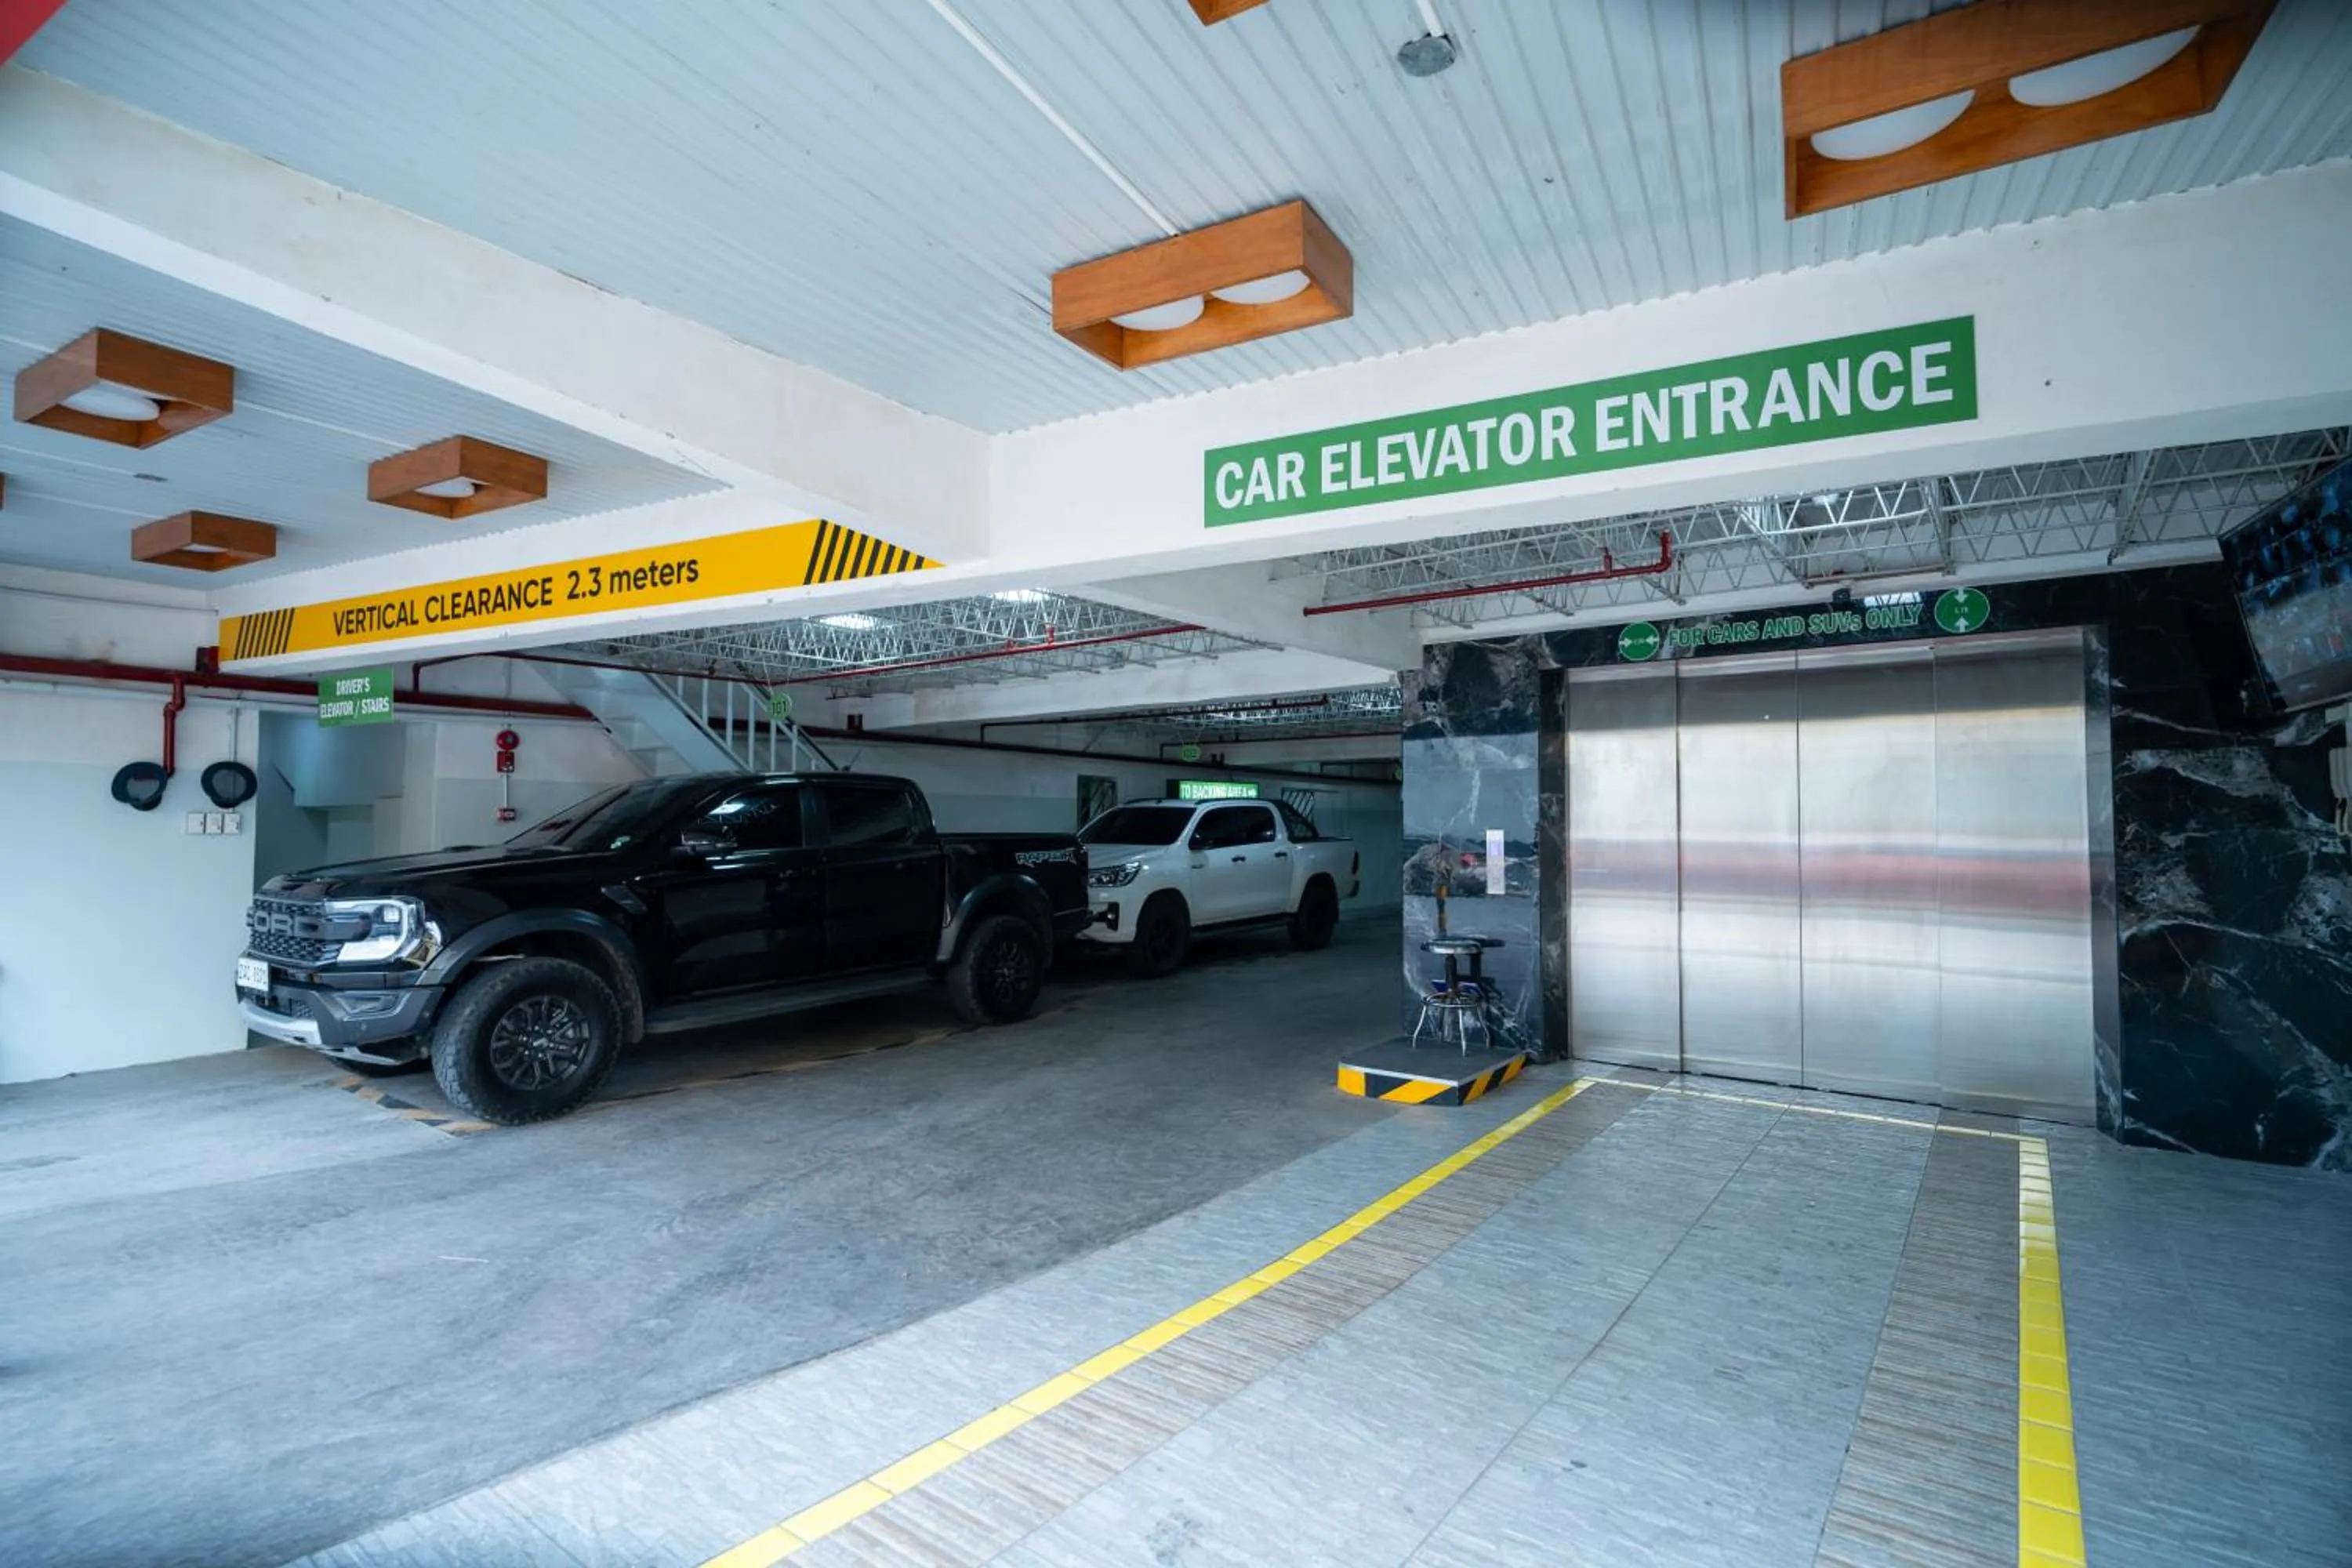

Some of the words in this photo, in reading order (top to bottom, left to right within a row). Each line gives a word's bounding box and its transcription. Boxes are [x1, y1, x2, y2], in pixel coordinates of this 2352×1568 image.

[1215, 451, 1306, 509] CAR
[1320, 406, 1577, 494] ELEVATOR
[1595, 342, 1952, 452] ENTRANCE
[333, 601, 419, 636] VERTICAL
[425, 577, 553, 623] CLEARANCE
[567, 567, 601, 600] 2.3
[610, 558, 699, 593] meters
[1668, 629, 1705, 647] FOR
[1707, 621, 1760, 644] CARS
[1762, 615, 1806, 639] AND
[1808, 611, 1863, 634] SUVs
[1865, 604, 1924, 630] ONLY
[320, 700, 354, 719] ELEVATOR
[361, 696, 390, 714] STAIRS
[1181, 785, 1191, 799] TO
